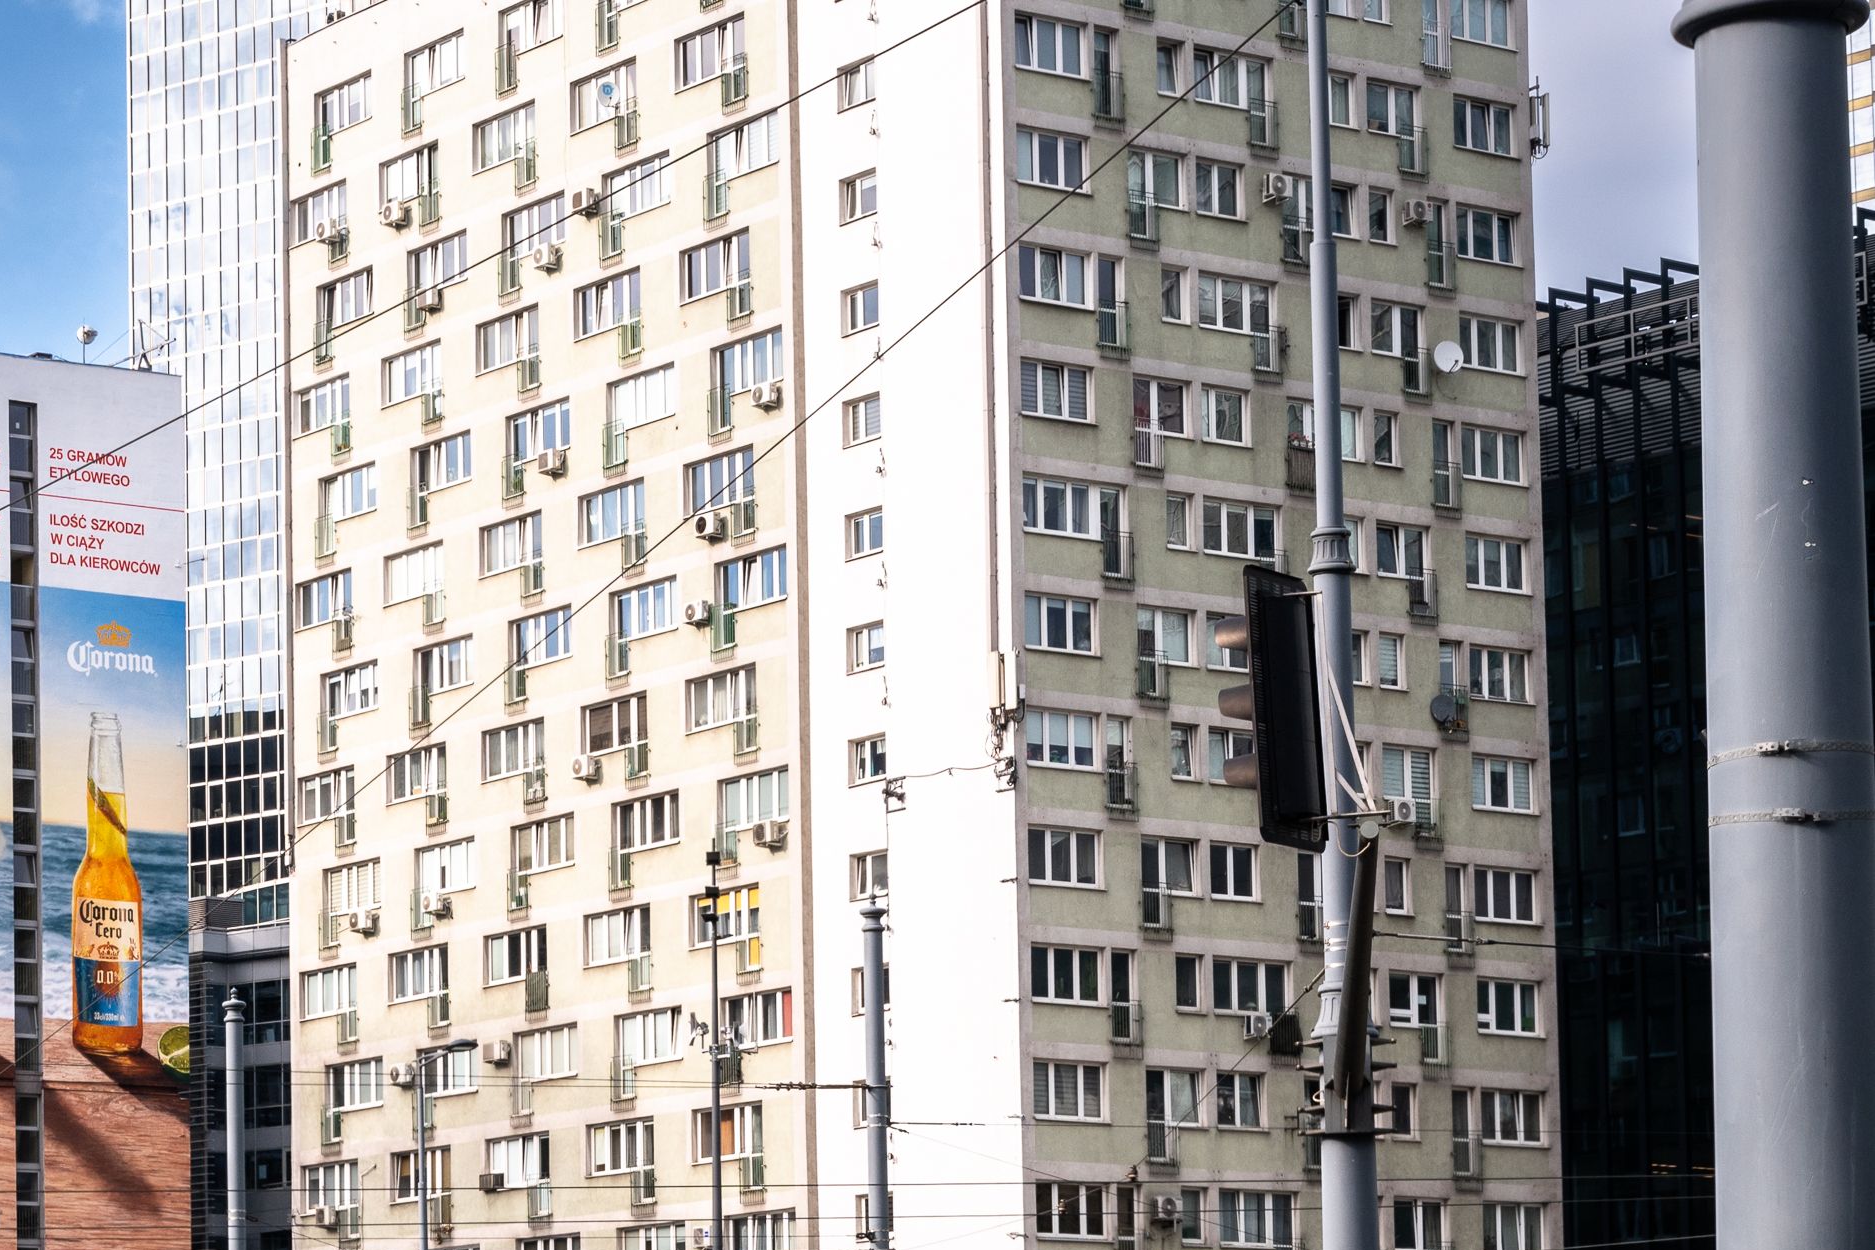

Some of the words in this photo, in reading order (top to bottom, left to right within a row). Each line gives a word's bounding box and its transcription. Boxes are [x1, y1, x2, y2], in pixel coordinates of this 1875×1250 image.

[49, 447, 63, 460] 25
[49, 466, 130, 487] ETYLOWEGO
[49, 514, 87, 529] ILOŚĆ
[90, 518, 145, 536] SZKODZI
[50, 532, 63, 545] W
[66, 535, 104, 551] CIĄŻY
[50, 552, 76, 566] DLA
[80, 555, 161, 576] KIEROWCÓW
[67, 640, 156, 677] Corona
[79, 899, 135, 927] Corona
[95, 922, 122, 940] Cero
